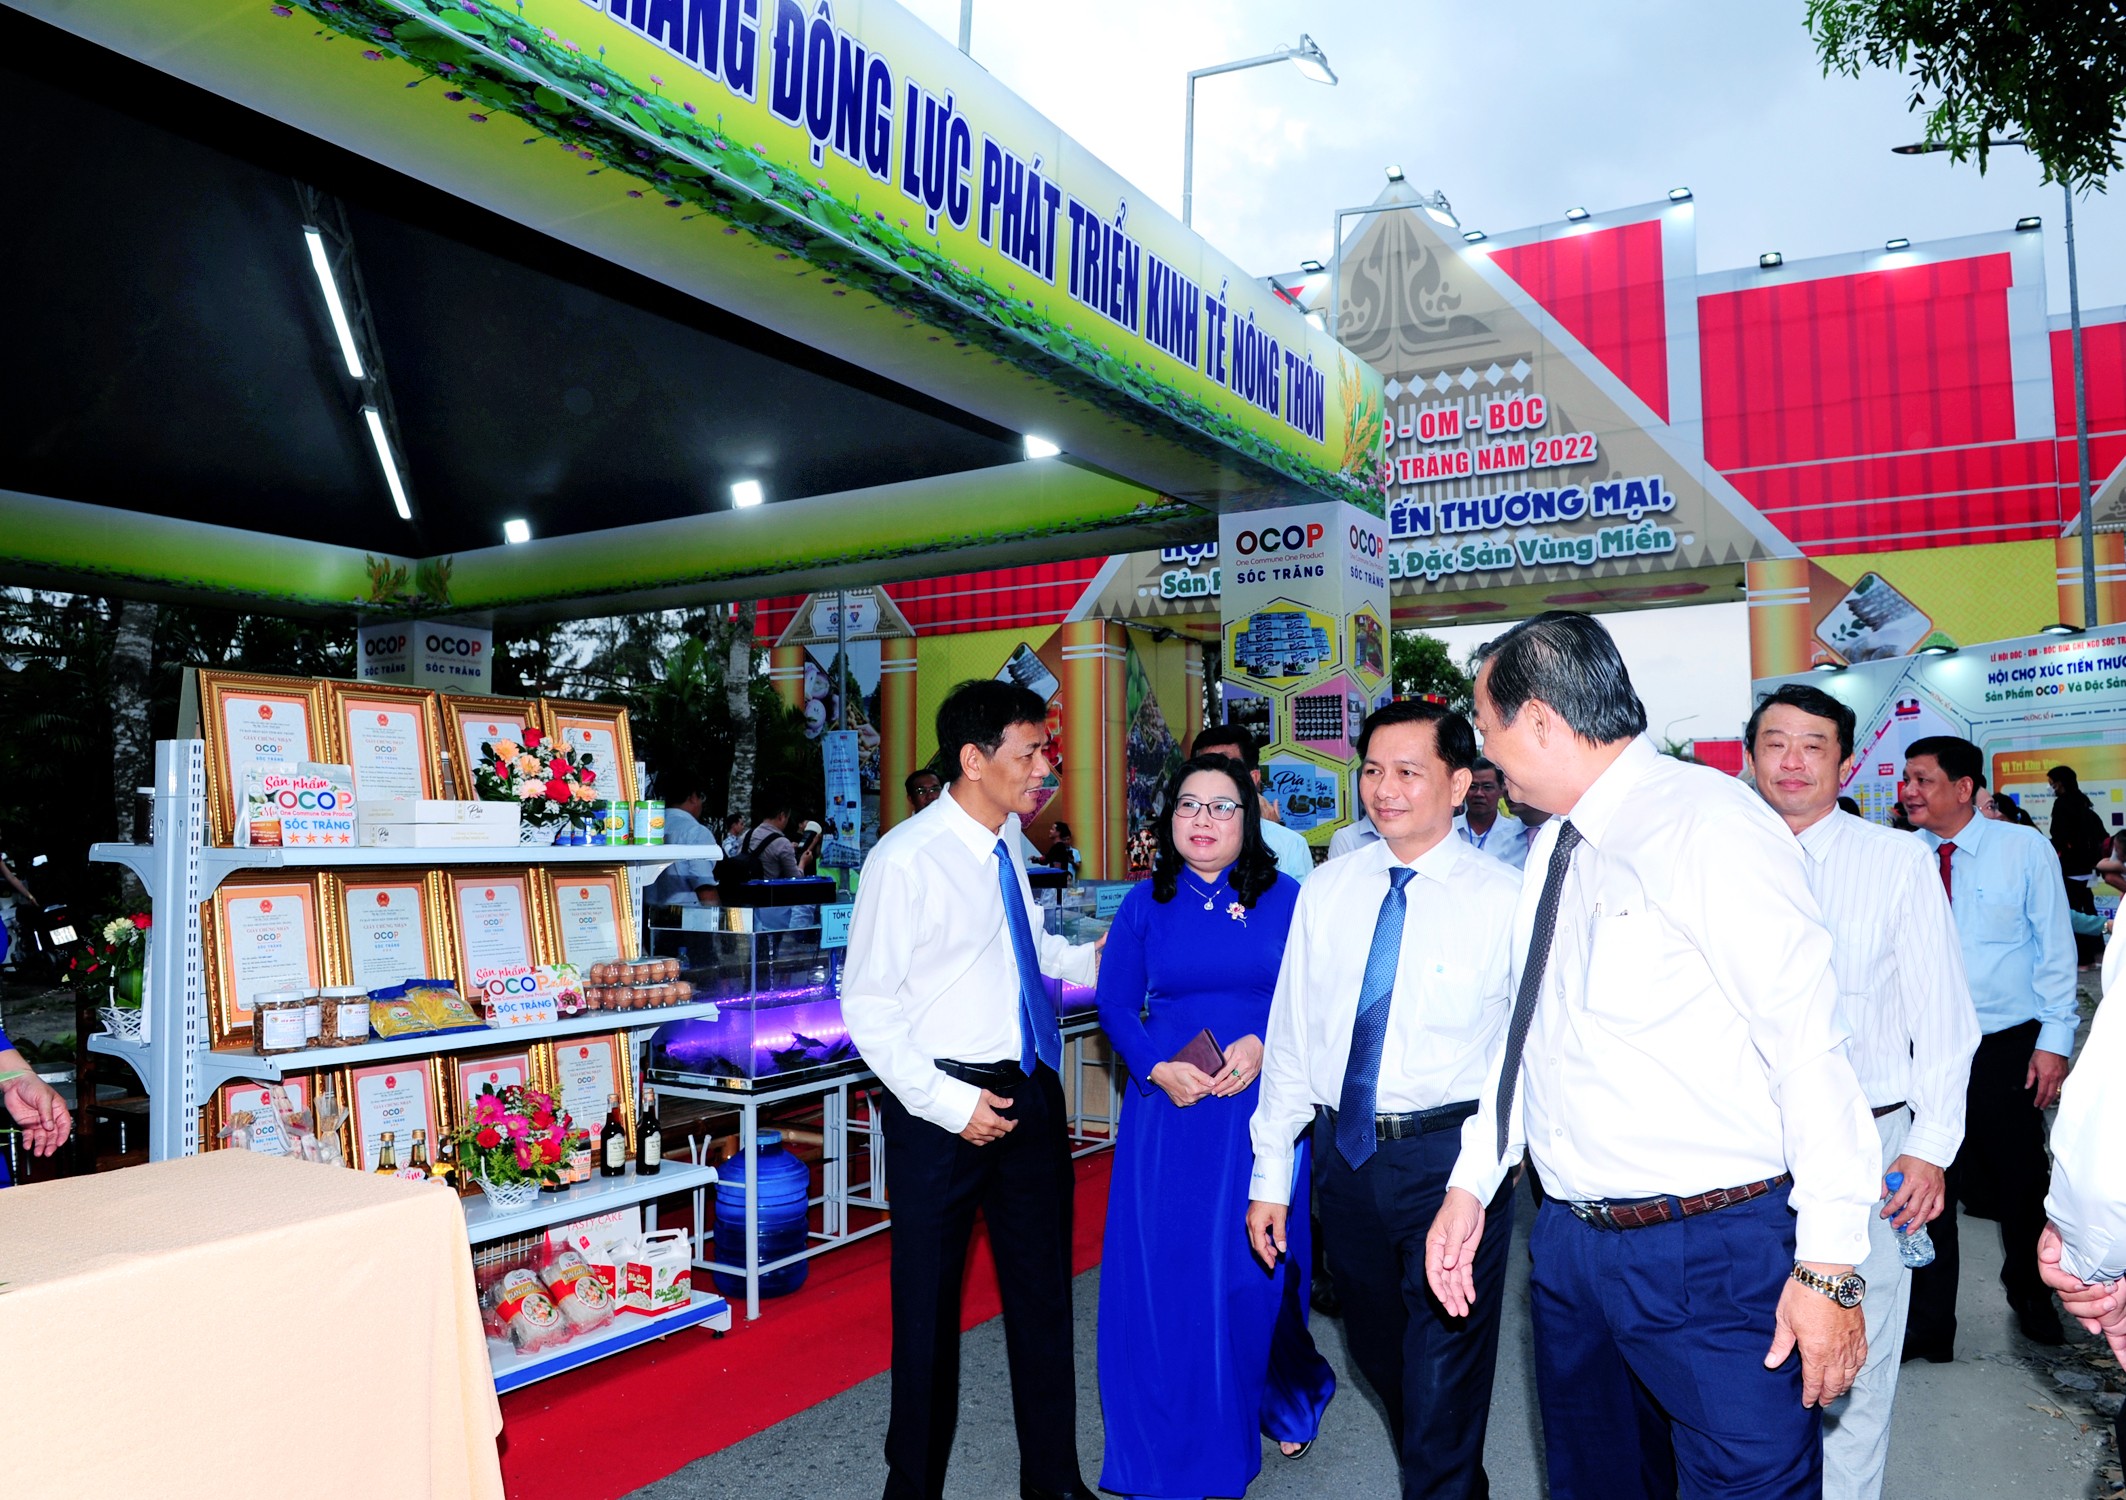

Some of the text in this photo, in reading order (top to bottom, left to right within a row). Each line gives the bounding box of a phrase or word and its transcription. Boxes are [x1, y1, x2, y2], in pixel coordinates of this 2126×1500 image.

[772, 0, 892, 179] ĐỘNG
[903, 83, 971, 230] LỰC
[981, 138, 1061, 280] PHÁT
[1068, 198, 1140, 332] TRIỂN
[1146, 254, 1199, 368] KINH
[1205, 280, 1227, 385] TẾ
[1231, 311, 1280, 417] NÔNG
[1285, 352, 1325, 442] THÔN
[1420, 410, 1458, 438] OM
[1489, 396, 1543, 429] BÓC
[1399, 451, 1469, 480] TRĂNG
[1478, 444, 1525, 470] NĂM
[1535, 435, 1593, 463] 2022
[1390, 479, 1671, 535] ẾN THƯƠNG MẠI,
[1236, 523, 1324, 555] OCOP
[1350, 524, 1383, 559] OCOP
[1250, 556, 1283, 566] Commune
[1300, 551, 1324, 559] Product
[1406, 550, 1453, 577] Đặc
[1460, 542, 1511, 568] Sản
[1518, 537, 1592, 562] Vùng
[1600, 524, 1672, 553] Miền
[1164, 571, 1207, 595] Sản
[1237, 567, 1266, 584] SÓC
[1273, 564, 1324, 580] TRĂNG
[1350, 566, 1384, 589] SÓC TRĂNG
[365, 635, 406, 657] OCOP
[425, 635, 482, 657] OCOP
[365, 665, 379, 676] SÓC
[425, 662, 445, 673] SÓC
[1988, 669, 2008, 686] HỘI
[2011, 666, 2036, 682] CHỢ
[2040, 662, 2063, 678] XÚC
[2067, 656, 2093, 674] TIẾN
[1985, 676, 2126, 702] Sản Phẩm OCOP Và Đặc Sản
[255, 744, 283, 753] OCOP
[374, 745, 396, 753] OCOP
[265, 775, 329, 791] Sản phẩm
[1273, 771, 1304, 794] Pía
[279, 791, 352, 810] OCOP
[285, 818, 350, 830] SÓC TRĂNG
[484, 918, 504, 926] OCOP
[257, 933, 281, 941] OCOP
[373, 931, 399, 940] OCOP
[476, 965, 528, 982] Sản phẩm
[489, 975, 549, 996] OCOP
[498, 999, 552, 1013] SÓC TRĂNG
[577, 1076, 595, 1084] OCOP
[382, 1107, 404, 1116] OCOP
[255, 1125, 275, 1136] OCO
[597, 1211, 623, 1223] CAKE
